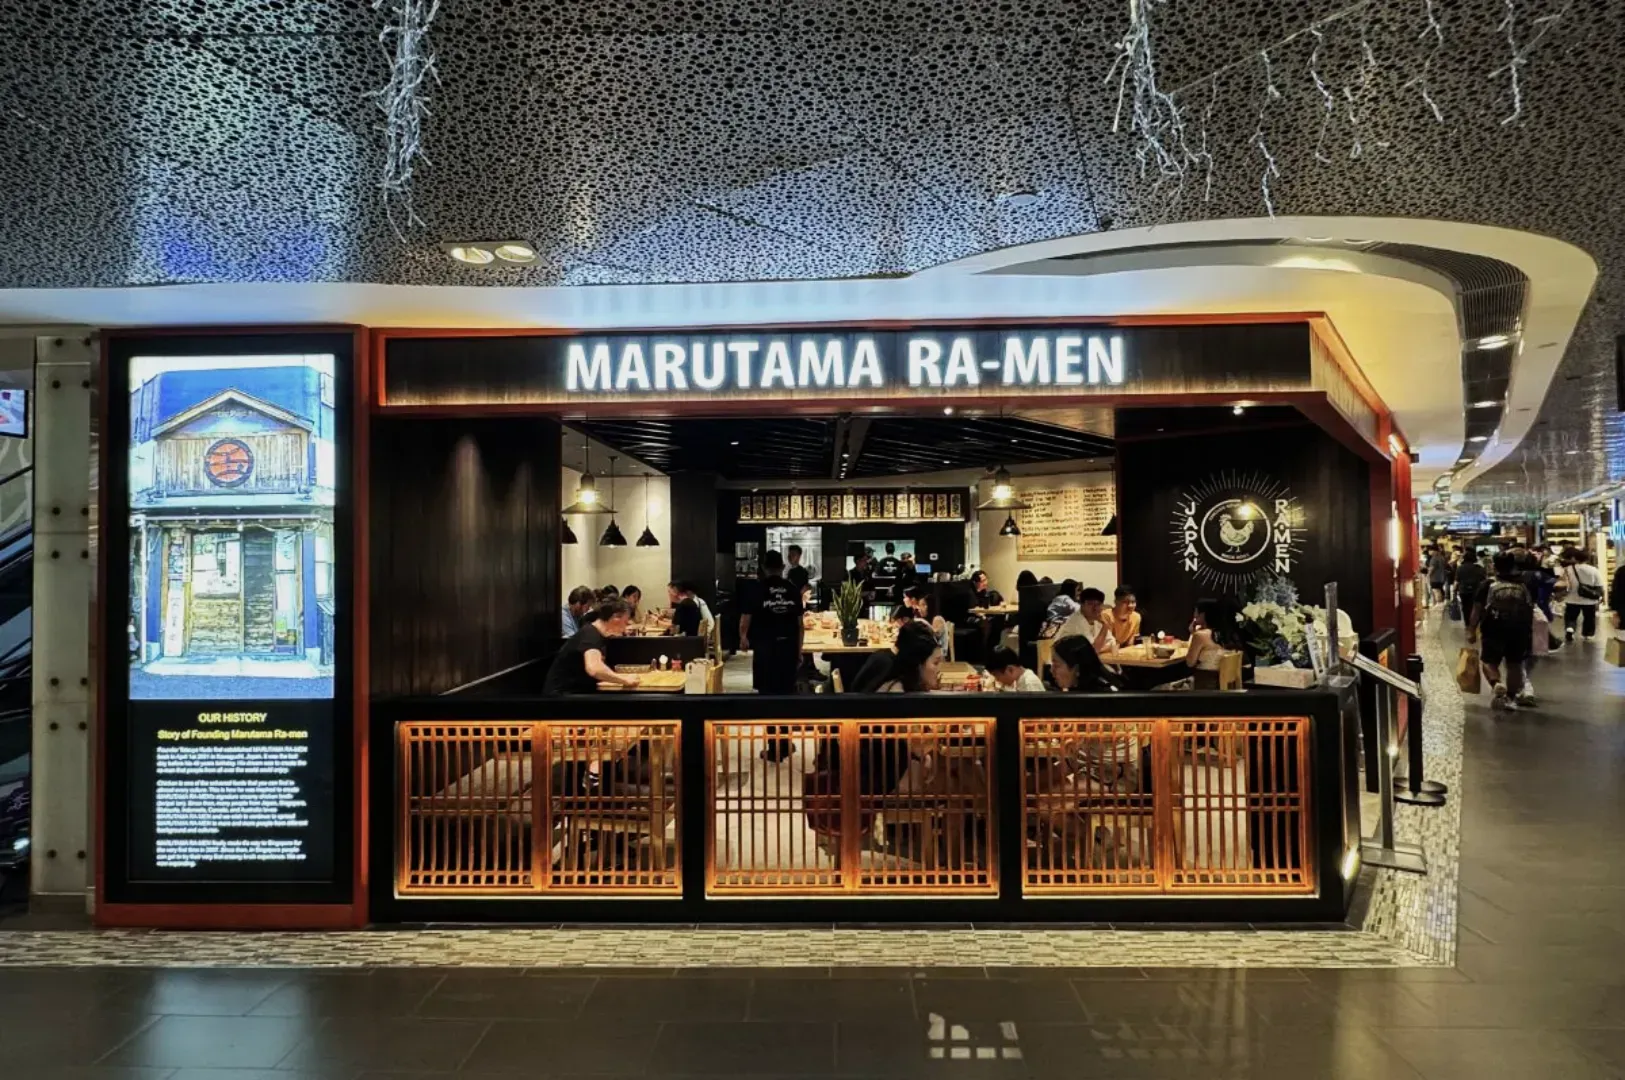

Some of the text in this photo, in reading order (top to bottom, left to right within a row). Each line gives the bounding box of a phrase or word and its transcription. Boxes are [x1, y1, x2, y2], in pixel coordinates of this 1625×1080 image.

[565, 336, 1125, 391] MARUTAMA RA-MEN
[1183, 501, 1198, 572] JAPAN
[157, 729, 179, 740] Story
[181, 729, 191, 739] of
[191, 729, 230, 740] Founding
[231, 729, 273, 739] Marutama
[198, 713, 268, 723] OUR HISTORY
